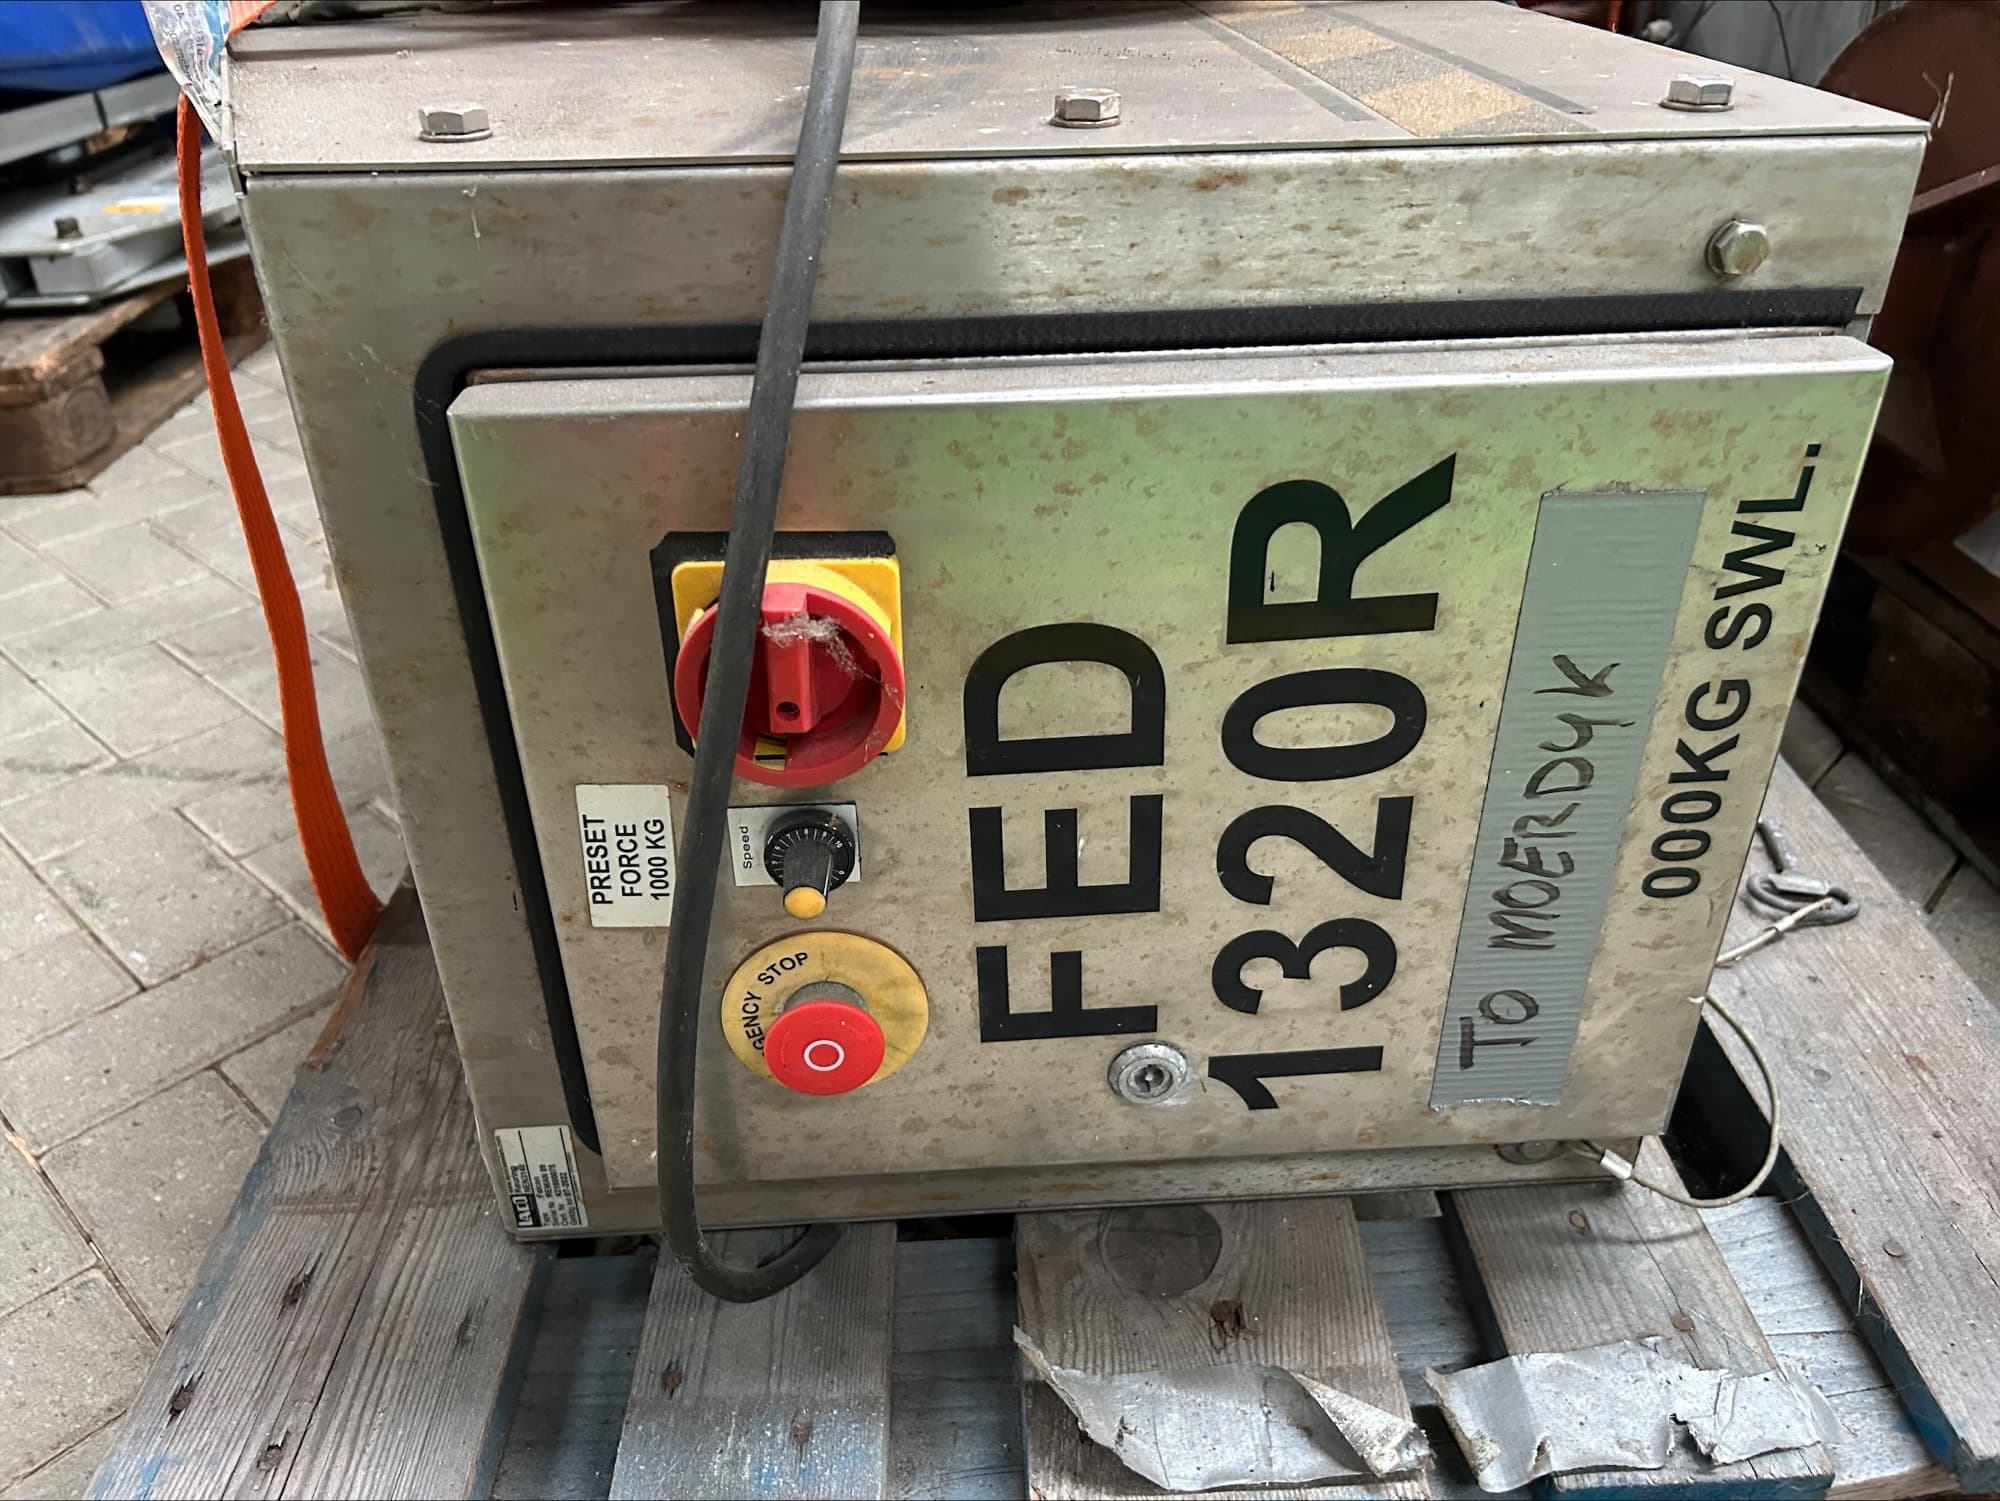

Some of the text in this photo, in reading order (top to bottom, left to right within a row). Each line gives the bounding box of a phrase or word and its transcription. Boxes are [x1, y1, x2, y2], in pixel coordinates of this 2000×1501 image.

[1704, 443, 1822, 651] SWL.
[1207, 453, 1457, 1111] 1320R
[582, 814, 614, 905] PRESET
[614, 823, 643, 897] FORCE
[644, 818, 670, 900] 1000 KG
[739, 825, 753, 870] Speed
[964, 623, 1166, 1044] FED
[741, 951, 810, 1058] GENCY STOP
[1458, 989, 1540, 1070] TO
